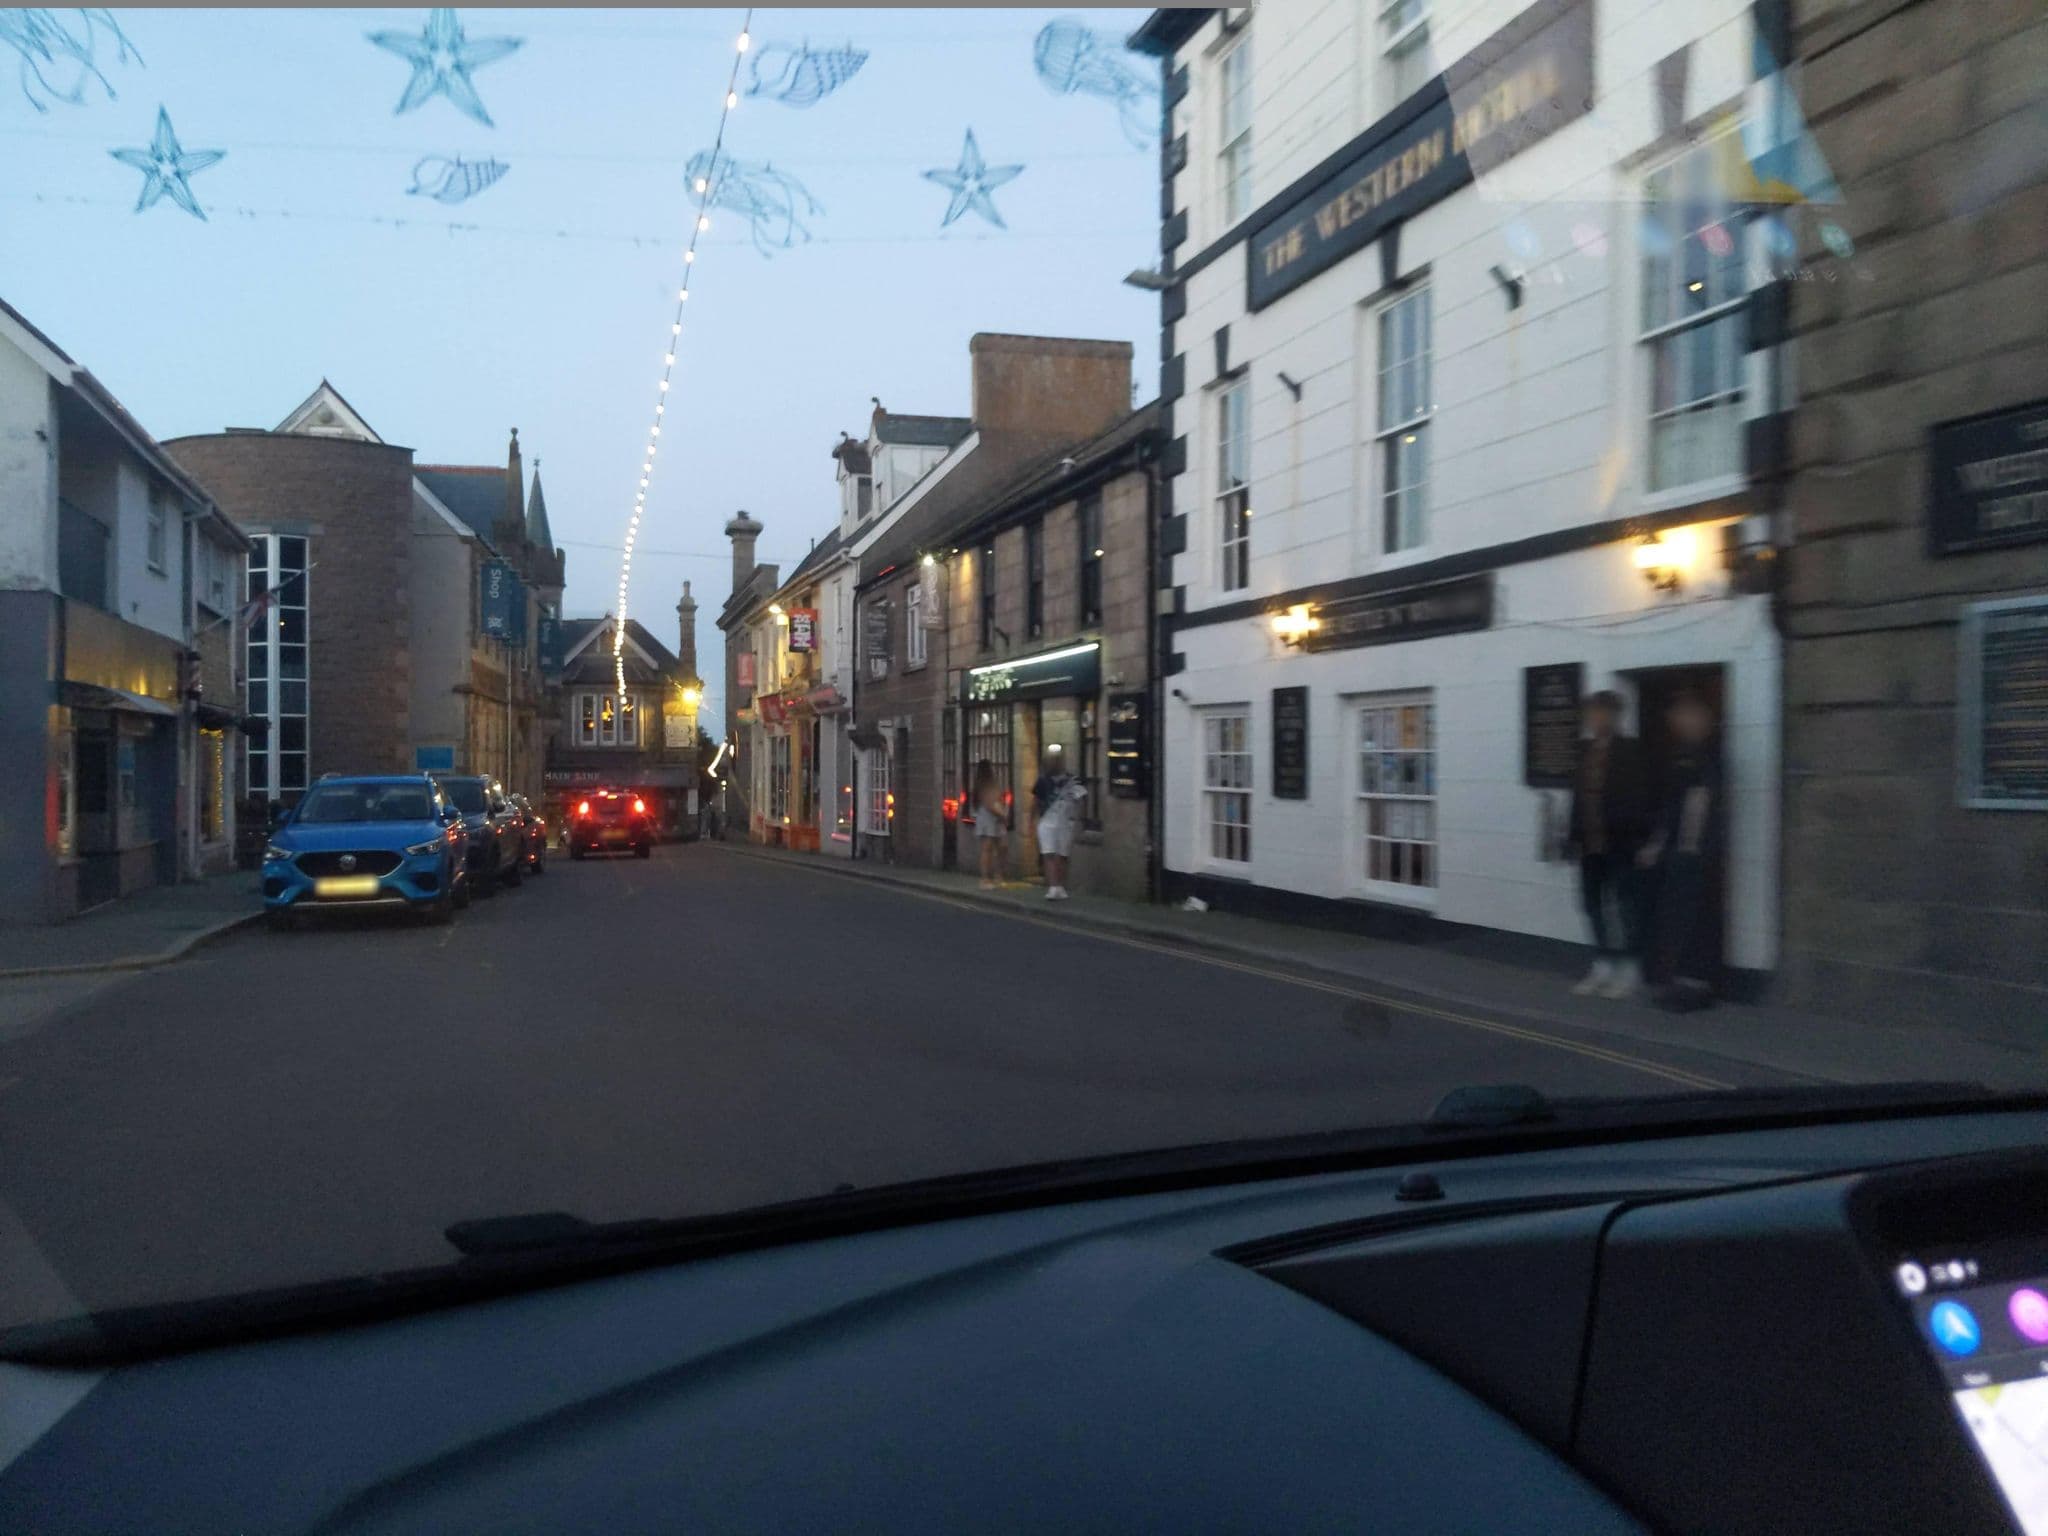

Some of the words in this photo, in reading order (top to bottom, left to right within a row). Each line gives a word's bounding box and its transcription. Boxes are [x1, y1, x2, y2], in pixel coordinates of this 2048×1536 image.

[1263, 225, 1304, 276] THE
[1312, 128, 1445, 241] WESTERN
[488, 568, 502, 599] Shop
